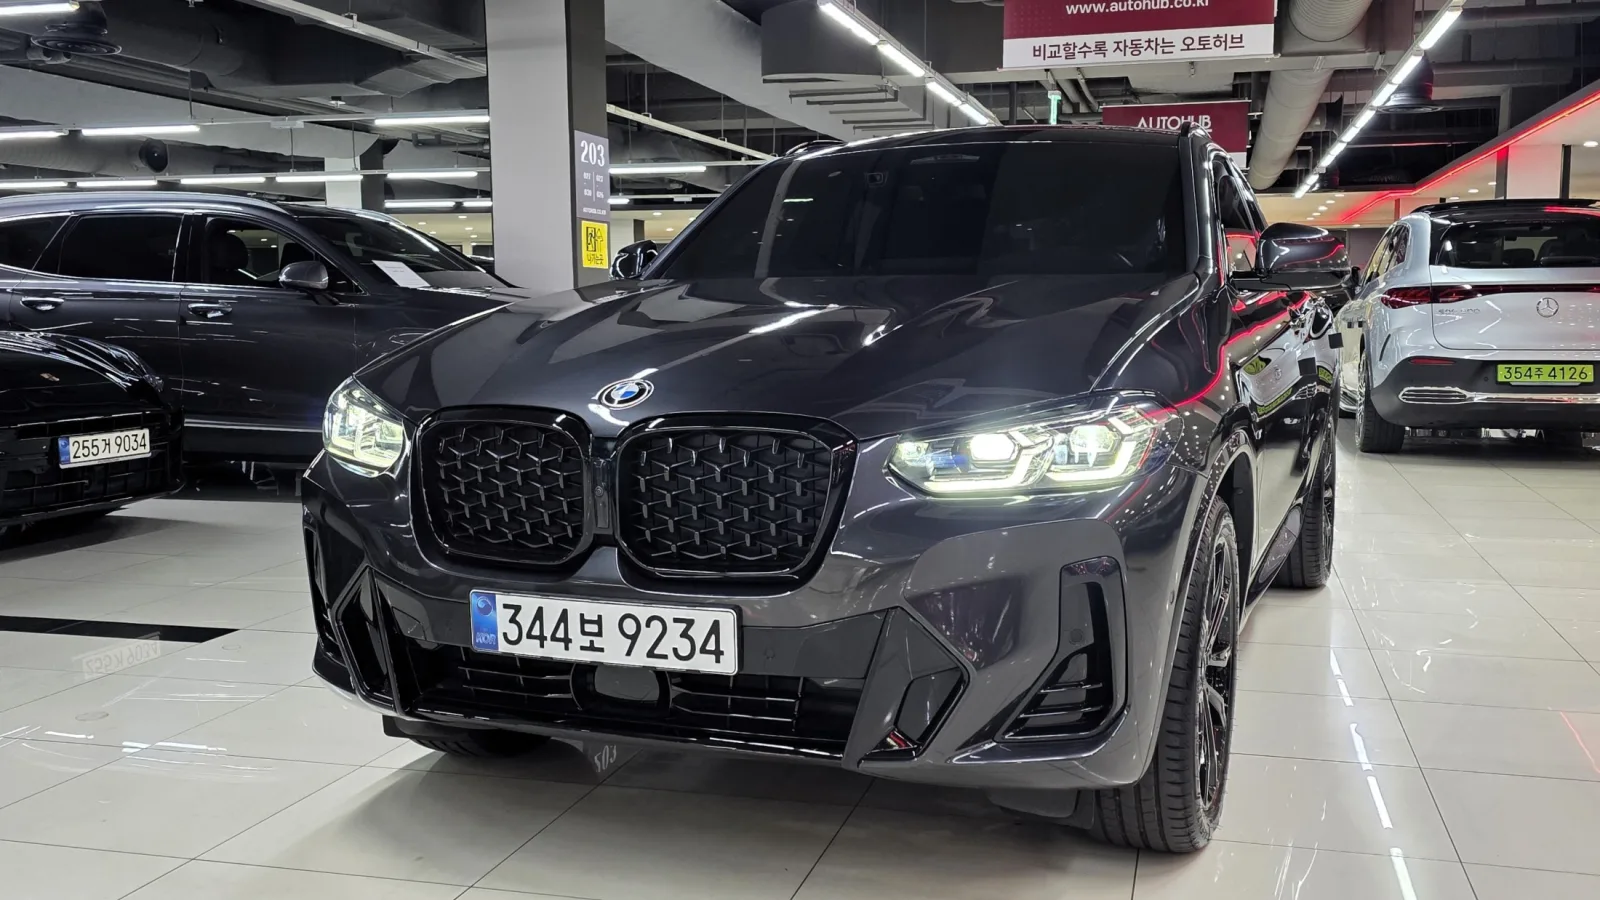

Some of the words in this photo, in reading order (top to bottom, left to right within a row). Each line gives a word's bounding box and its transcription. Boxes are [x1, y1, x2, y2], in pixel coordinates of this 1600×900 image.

[1032, 41, 1108, 61] 비교할수록
[1113, 37, 1176, 57] 자동차는
[1180, 33, 1245, 52] 오토허브
[580, 140, 605, 167] 203
[1503, 366, 1544, 380] 354주
[1548, 366, 1588, 380] 4126
[72, 438, 111, 459] 255거
[114, 432, 147, 454] 9034
[475, 632, 497, 646] KOR
[502, 603, 605, 653] 344보
[617, 612, 725, 665] 9234
